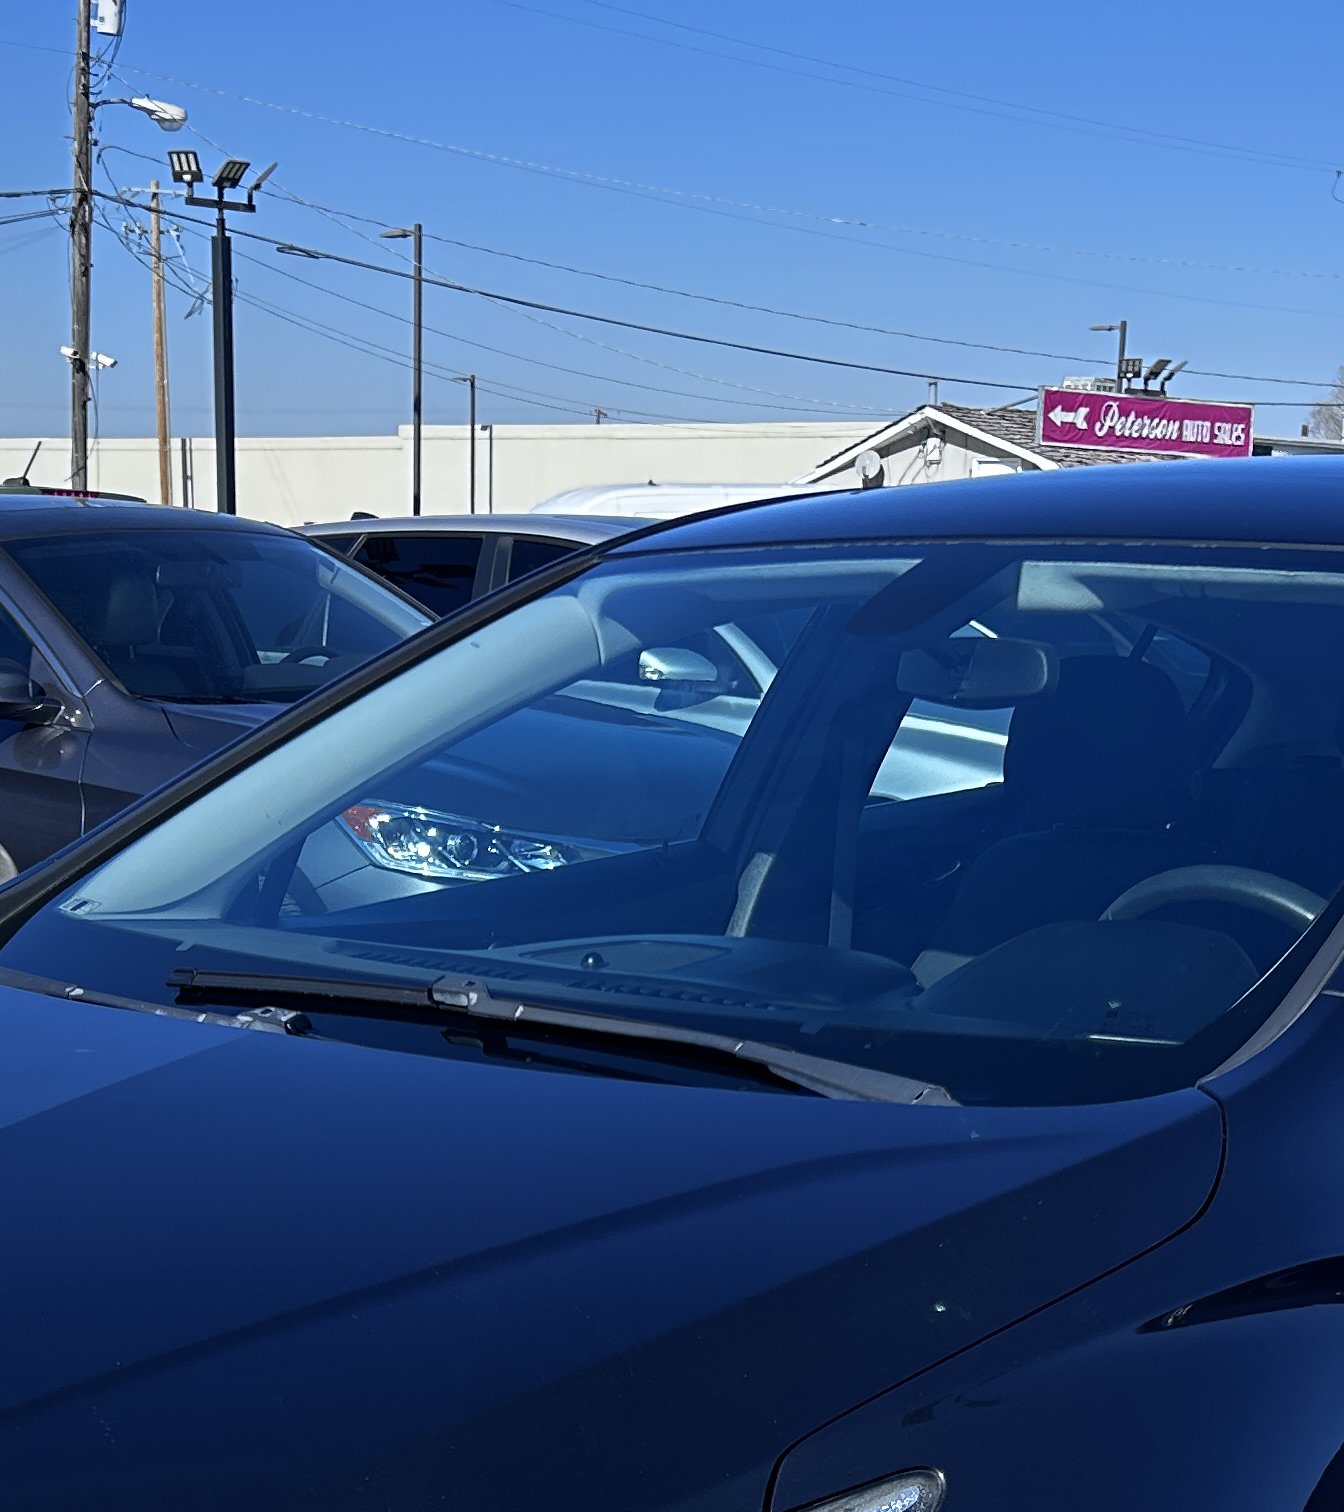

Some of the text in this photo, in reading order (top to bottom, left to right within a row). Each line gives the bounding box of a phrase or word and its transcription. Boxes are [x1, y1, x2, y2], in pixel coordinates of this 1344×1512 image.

[1094, 401, 1245, 445] Peterson AUTO SALES
